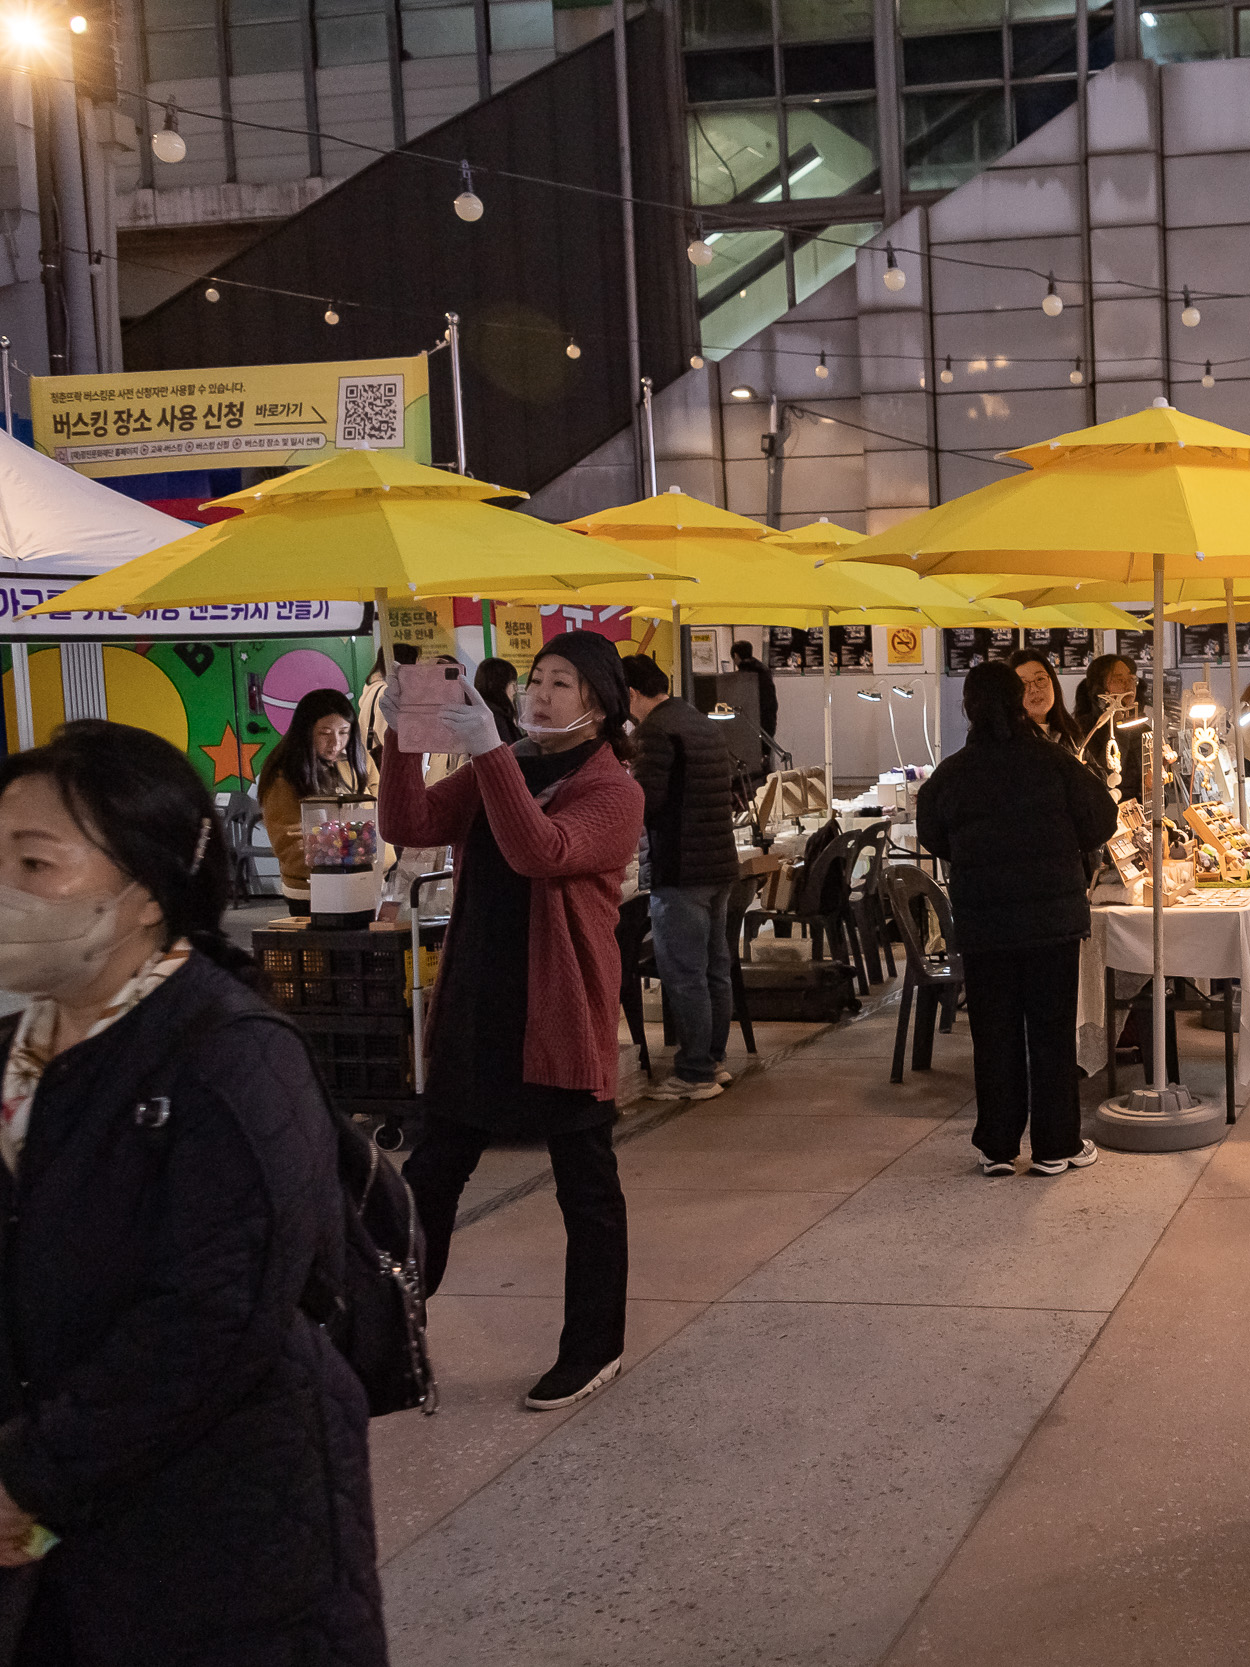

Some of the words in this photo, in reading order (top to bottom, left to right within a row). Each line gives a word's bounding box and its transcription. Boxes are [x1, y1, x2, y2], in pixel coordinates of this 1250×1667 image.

[50, 391, 82, 404] 청춘뜨락
[83, 389, 116, 402] 버스킹은
[118, 387, 134, 400] 사전
[135, 386, 168, 399] 신청자만
[170, 383, 195, 397] 사용할
[198, 383, 206, 395] 수
[208, 382, 246, 395] 있습니다.
[255, 402, 303, 418] 바로가기
[52, 409, 108, 440] 버스킹
[112, 408, 152, 436] 장소
[157, 403, 198, 433] 사용
[202, 401, 245, 430] 신청
[195, 441, 216, 451] 버스킹
[244, 438, 265, 449] 버스킹
[266, 438, 280, 448] 장소
[281, 437, 289, 447] 및
[306, 436, 320, 446] 선택
[388, 610, 438, 627] 청춘뜨락
[393, 628, 414, 641] 사용
[414, 628, 434, 641] 안내
